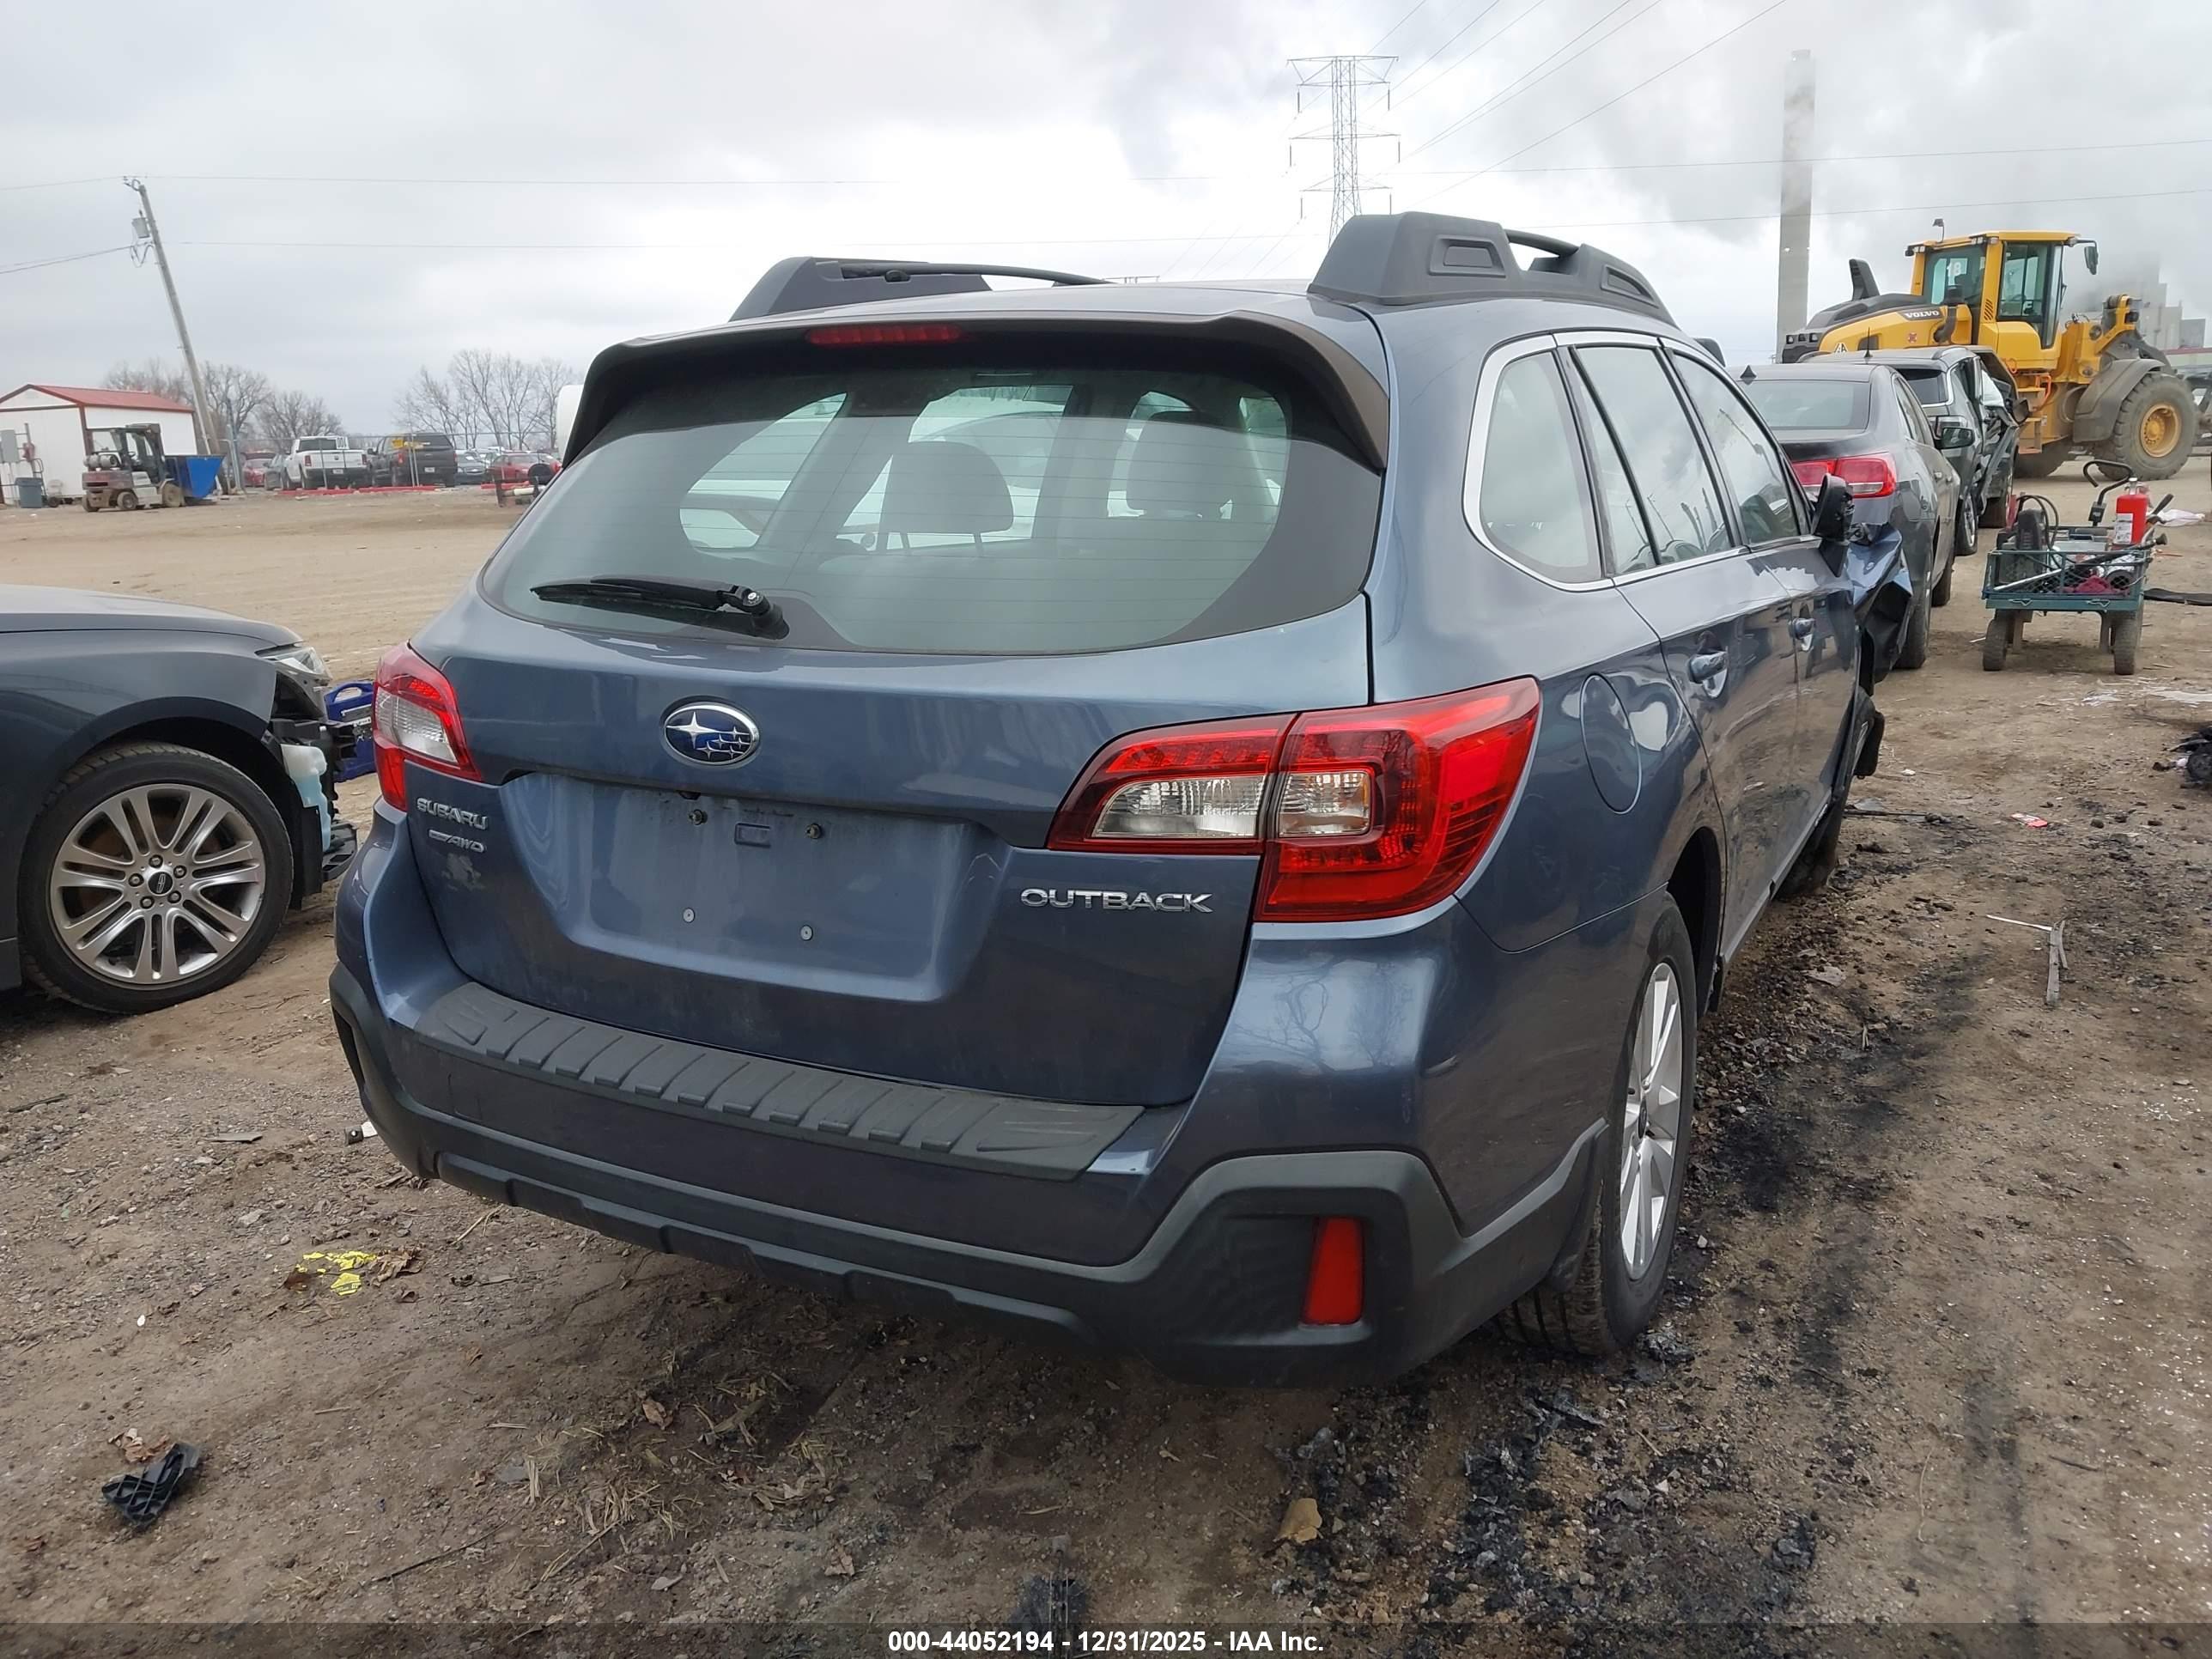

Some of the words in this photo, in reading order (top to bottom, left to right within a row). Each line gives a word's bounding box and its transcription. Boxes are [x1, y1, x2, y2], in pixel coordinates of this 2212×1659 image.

[1904, 310, 1940, 319] VOLVO
[416, 797, 489, 830] SUBARU
[447, 835, 485, 853] AWD
[1020, 888, 1214, 914] OUTBACK
